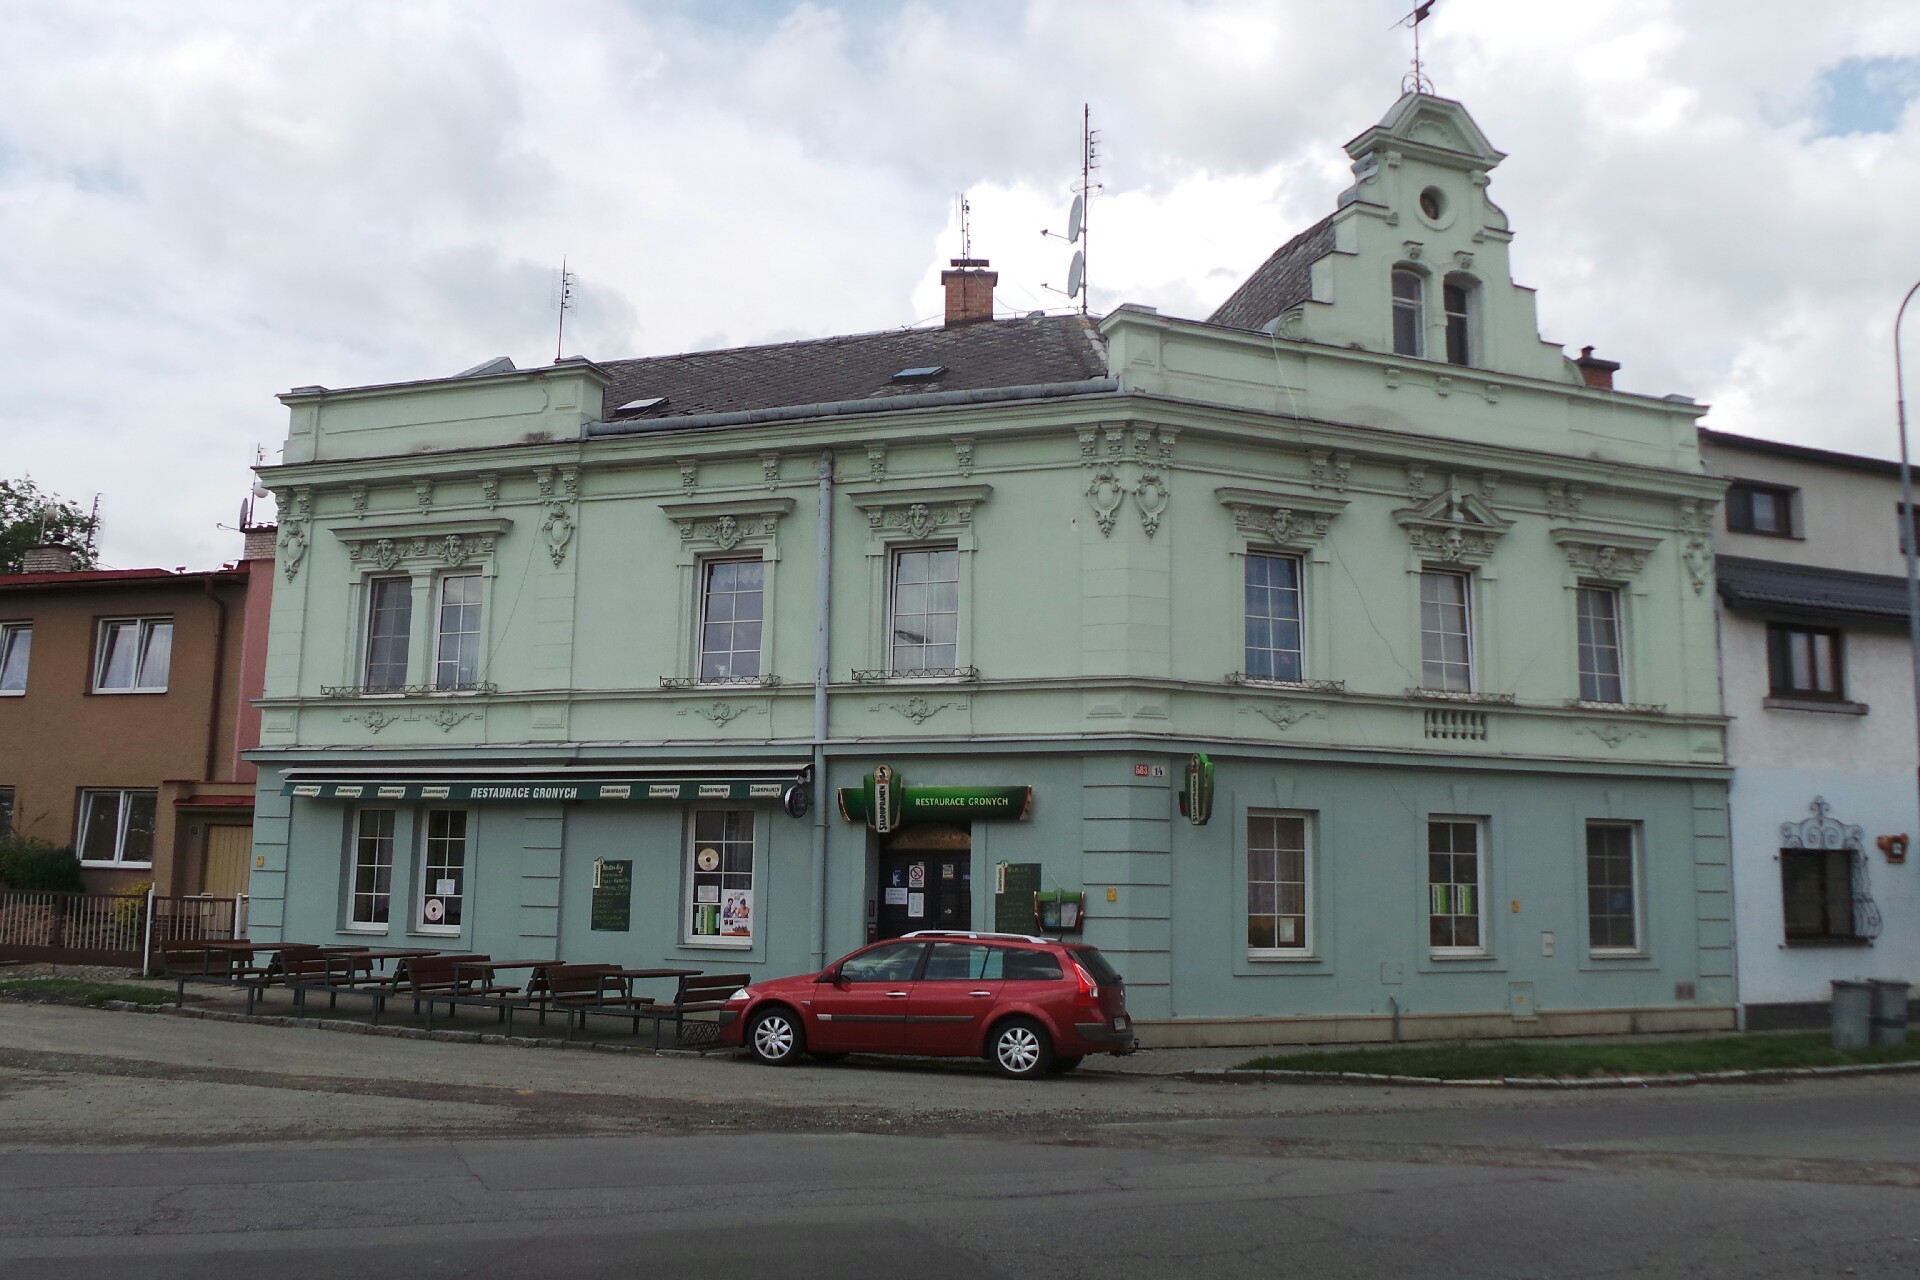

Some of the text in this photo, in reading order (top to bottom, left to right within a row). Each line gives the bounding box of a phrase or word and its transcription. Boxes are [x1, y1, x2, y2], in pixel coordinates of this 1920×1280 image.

[470, 787, 578, 798] RESTAURACE GRONYCH
[915, 797, 1008, 806] RESTAURACE GRONYCH
[879, 785, 887, 831] STAROPRAMEN
